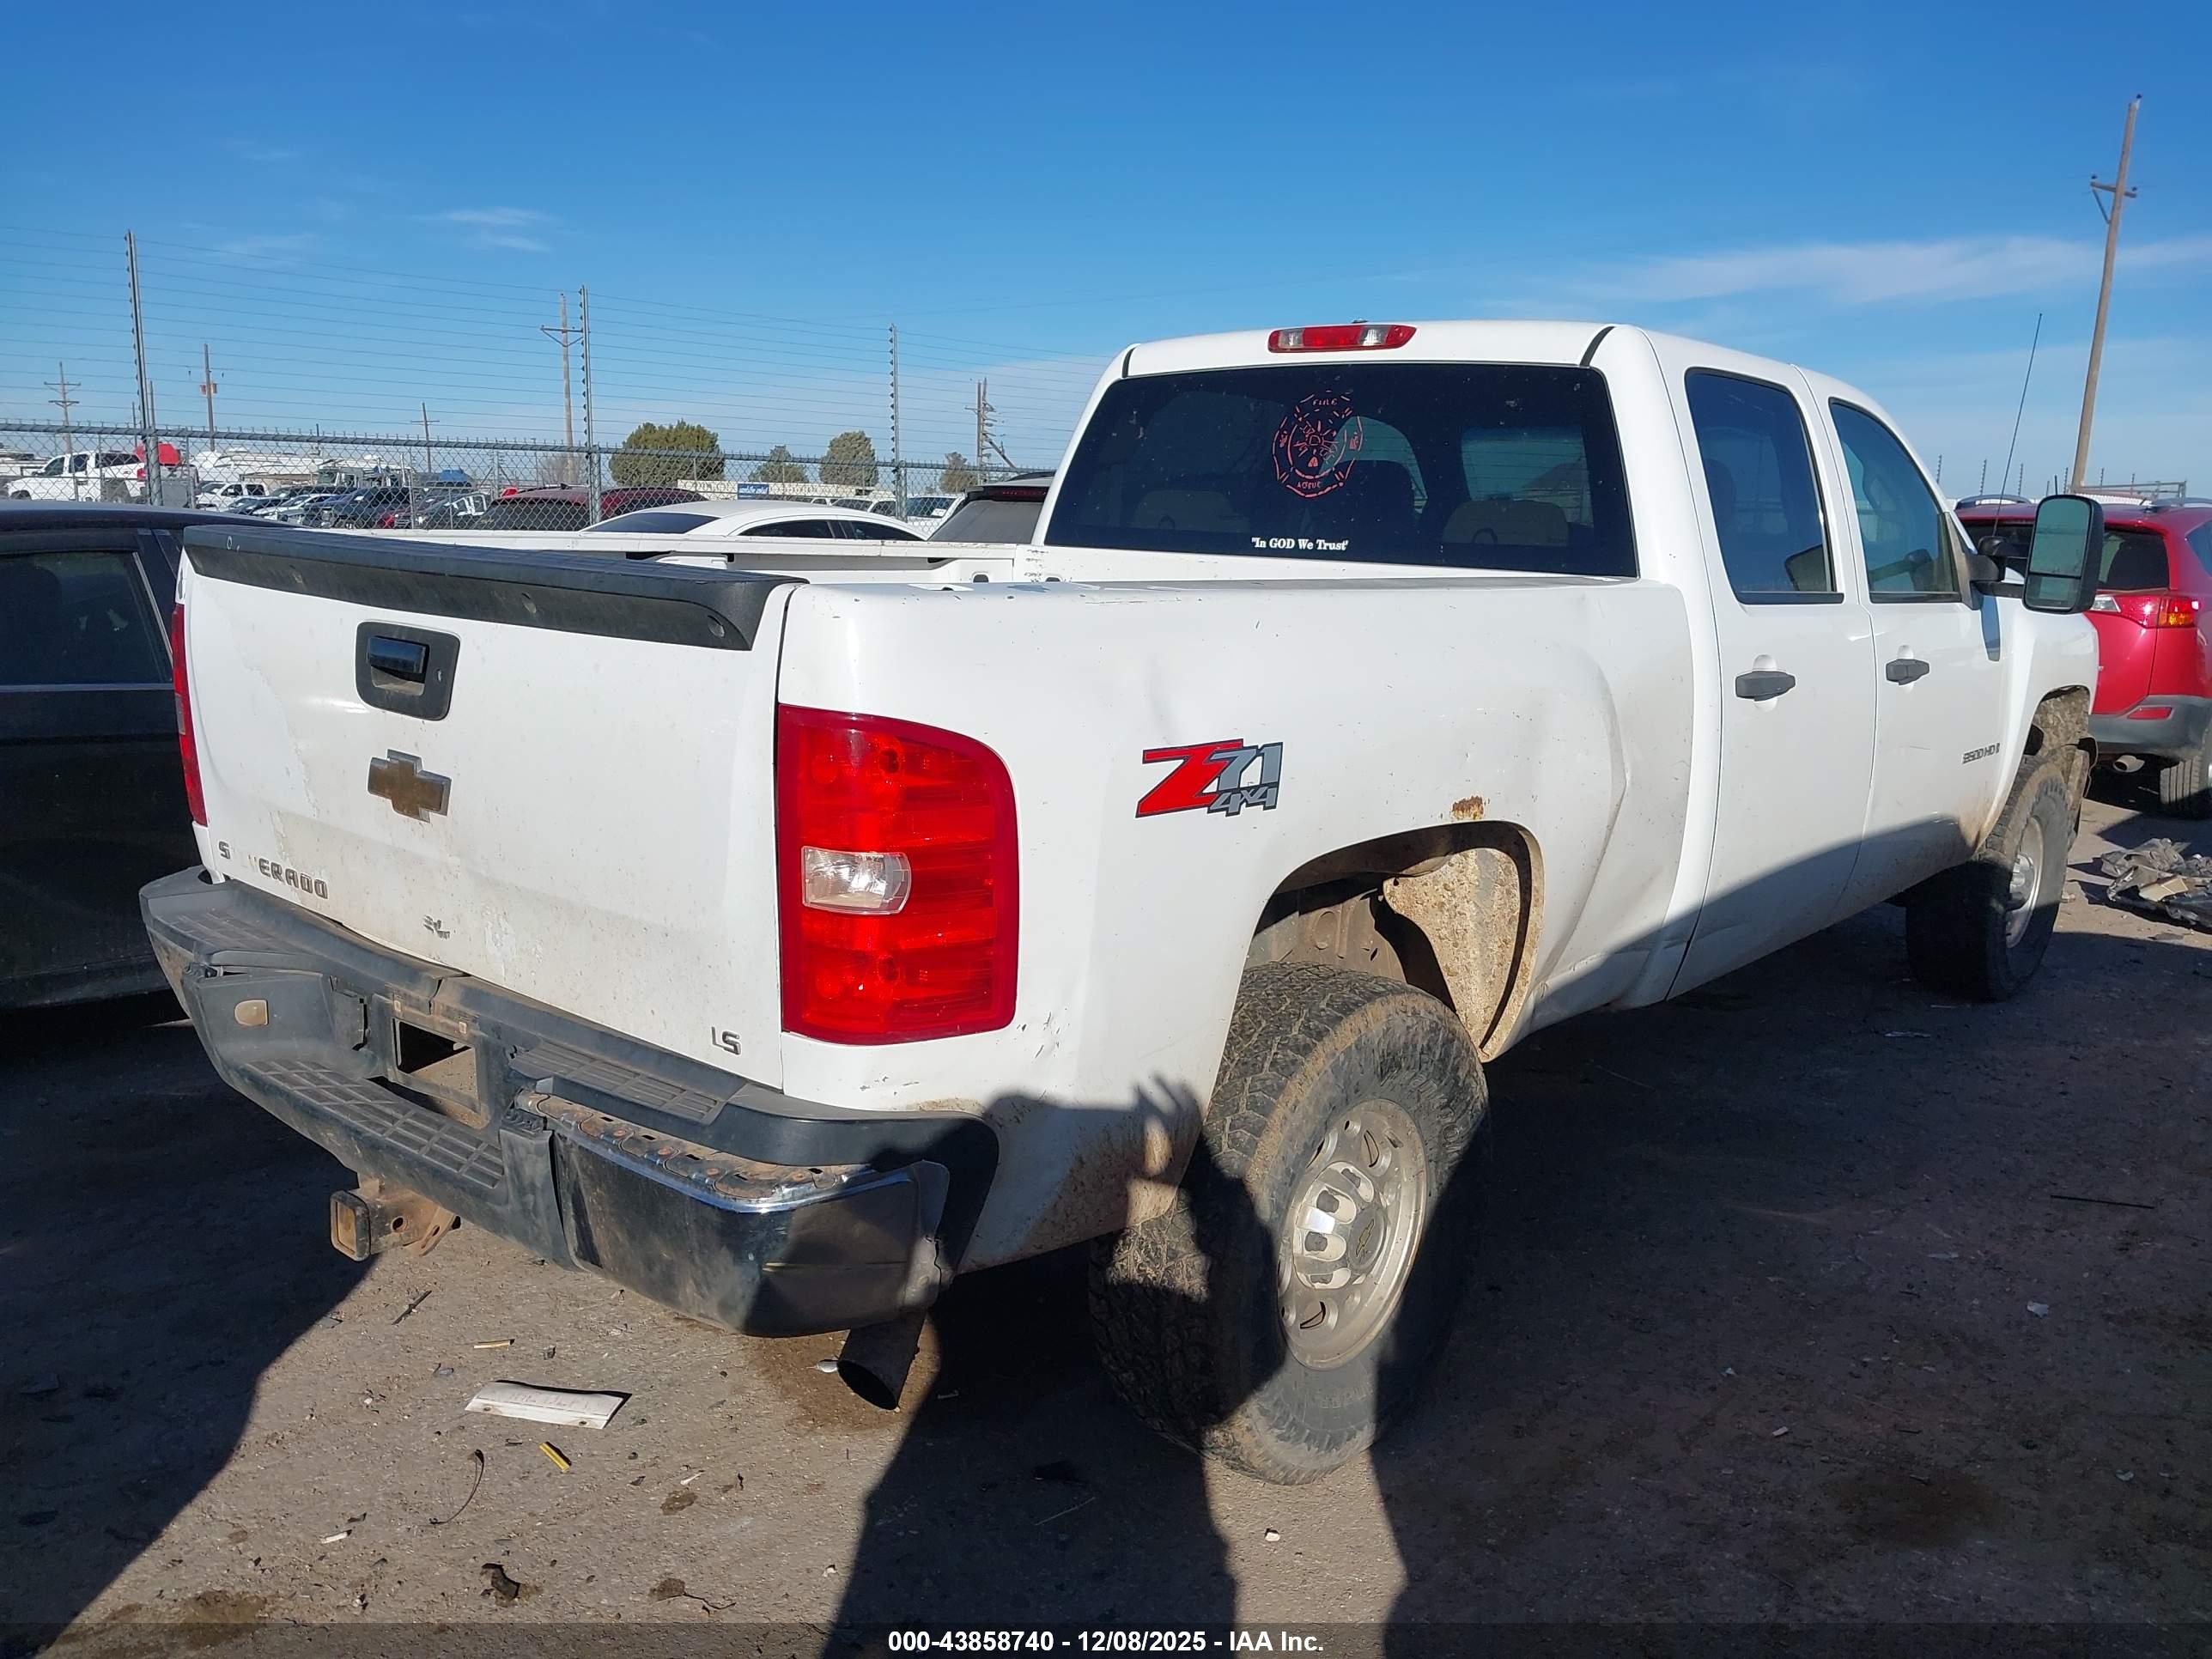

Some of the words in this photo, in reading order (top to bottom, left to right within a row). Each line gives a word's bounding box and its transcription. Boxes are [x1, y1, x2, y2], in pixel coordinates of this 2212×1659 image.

[1269, 538, 1295, 549] GOD
[1298, 538, 1314, 550] We
[1135, 738, 1284, 818] Z71
[711, 1025, 741, 1055] LS
